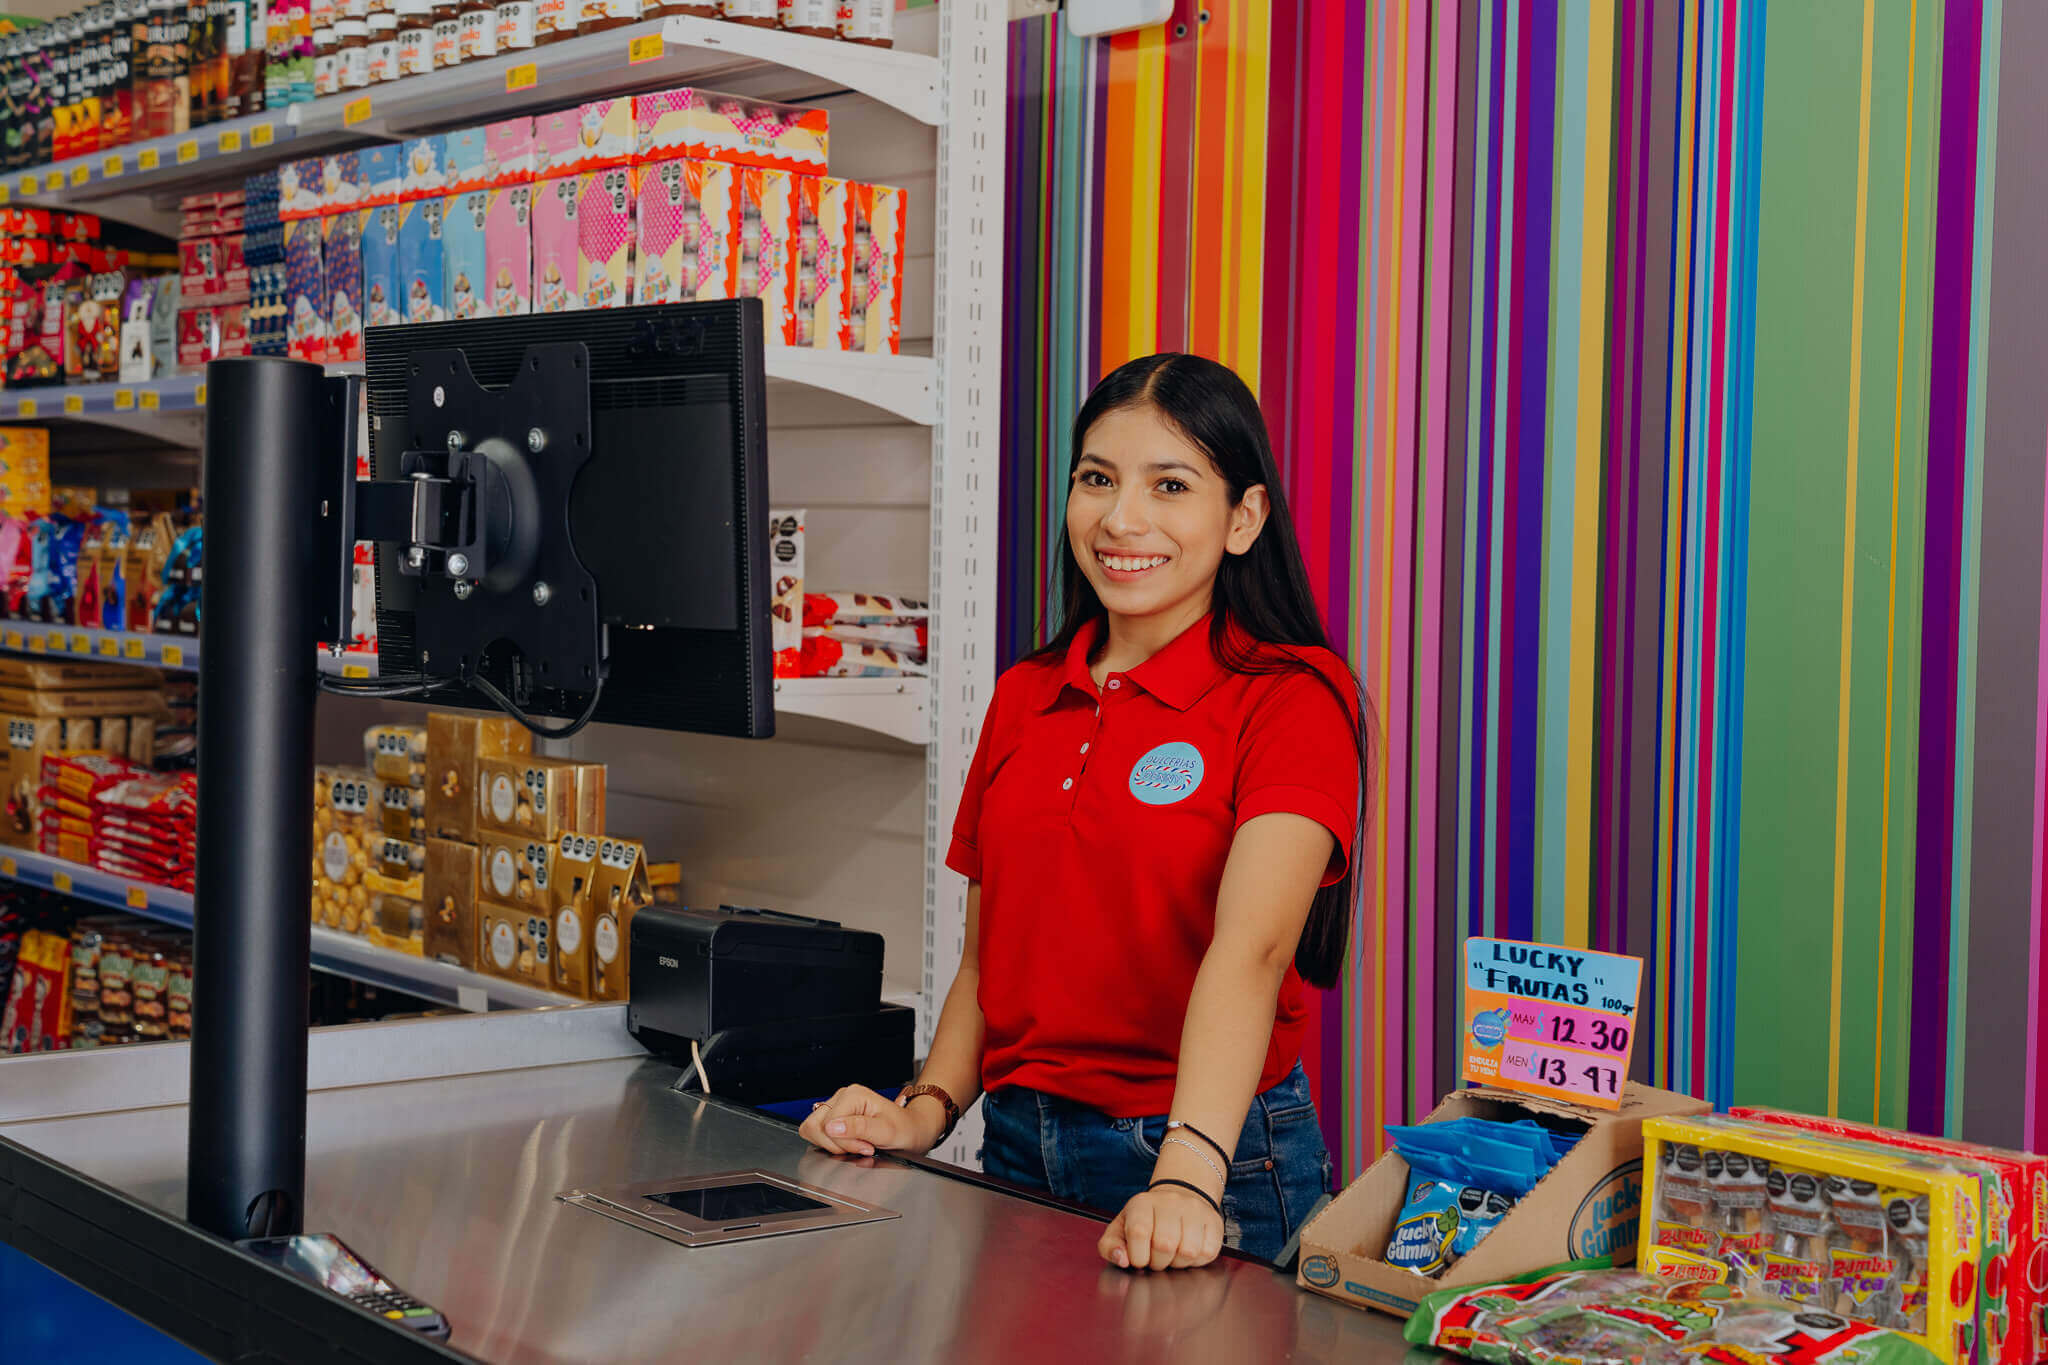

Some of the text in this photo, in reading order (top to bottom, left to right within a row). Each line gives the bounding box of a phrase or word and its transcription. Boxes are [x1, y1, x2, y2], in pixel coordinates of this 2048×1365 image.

[659, 956, 679, 969] EPSON
[1493, 944, 1584, 977] LUCKY
[1512, 1013, 1535, 1025] MAY
[1506, 1055, 1528, 1067] MEN
[1592, 1177, 1641, 1232] Luck
[1396, 1219, 1434, 1246] Lucky
[1581, 1216, 1640, 1258] Gumm
[1659, 1263, 1719, 1281] Zumba
[1831, 1256, 1894, 1278] Zumba
[1779, 1277, 1822, 1295] Rica
[1842, 1273, 1885, 1293] Rica
